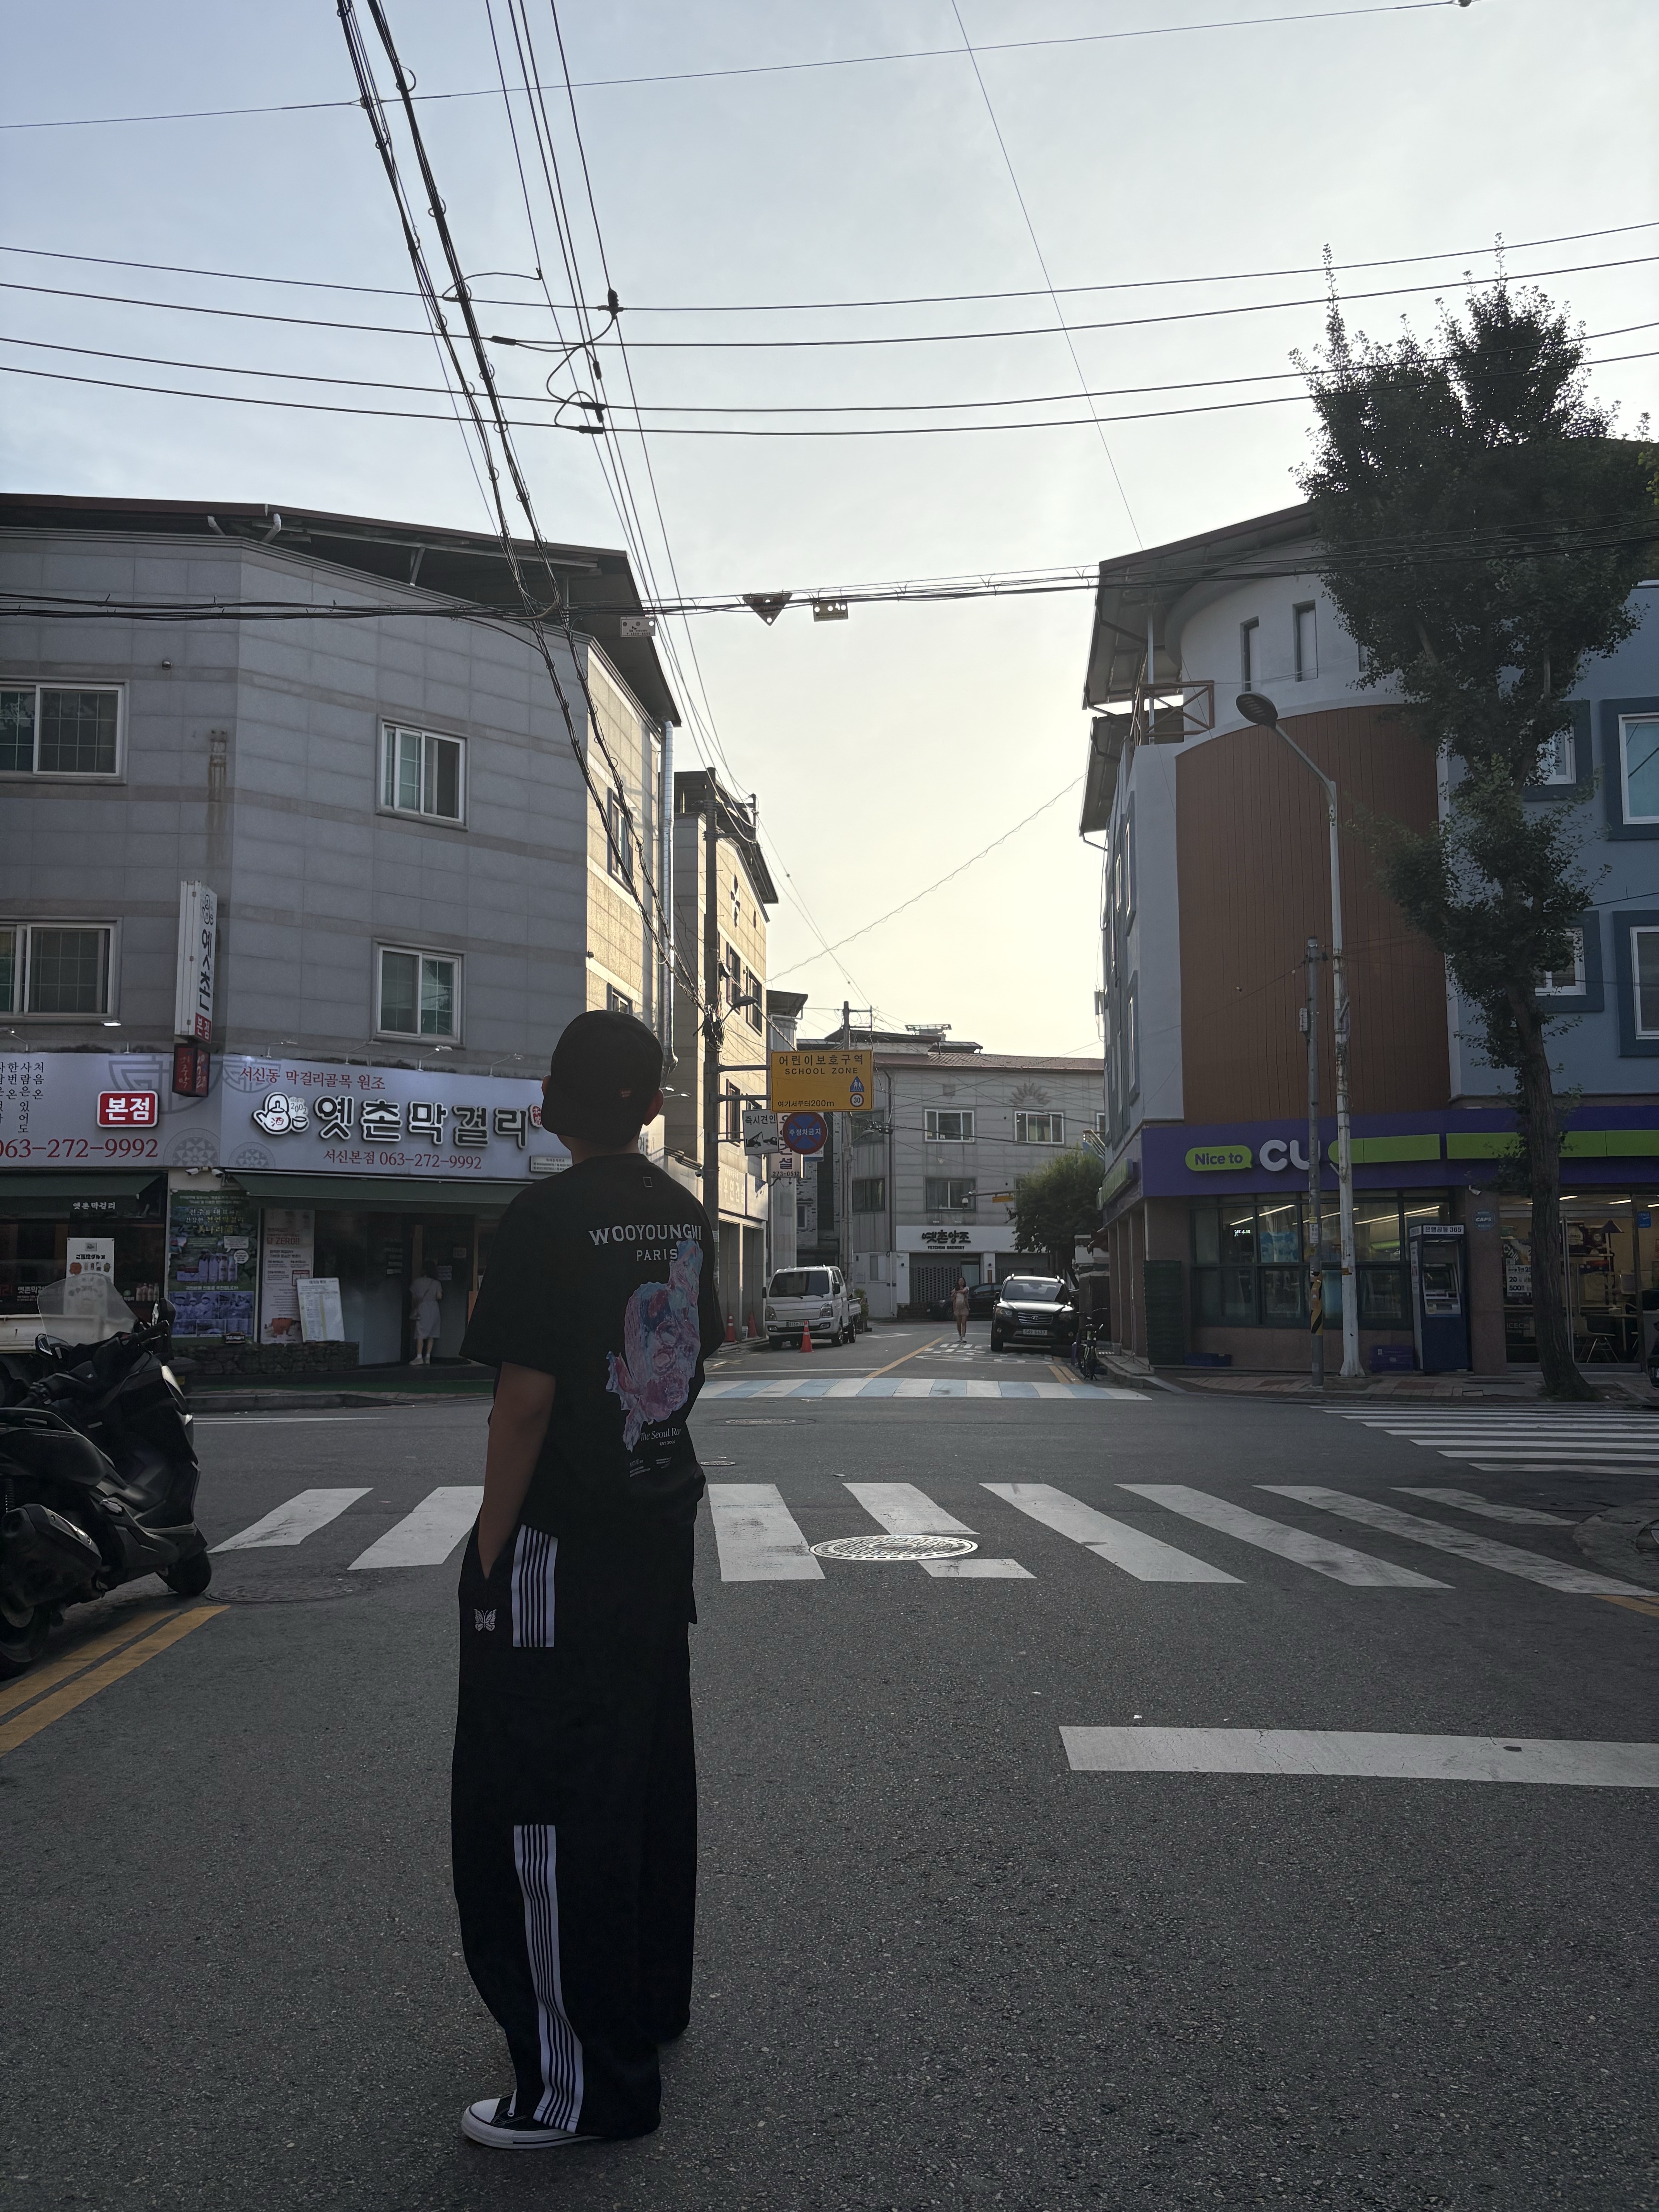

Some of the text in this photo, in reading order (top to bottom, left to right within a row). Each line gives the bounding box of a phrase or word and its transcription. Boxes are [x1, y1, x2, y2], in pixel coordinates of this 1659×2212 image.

[196, 1015, 211, 1040] 본점
[779, 1054, 863, 1065] 어린이보호구역
[6, 1062, 19, 1100] 한번 온
[32, 1061, 45, 1100] 처음 온
[239, 1066, 385, 1090] 서신동 막걸리골목 원조
[17, 1061, 32, 1133] 사람은 있어도
[105, 1097, 149, 1121] 본점
[291, 1103, 307, 1115] 2002
[744, 1114, 776, 1125] 즉시견인
[314, 1096, 527, 1147] 옛촌막걸리
[789, 1128, 821, 1137] 주정차금지
[323, 1149, 482, 1169] 서신본점 063-272-9992
[1194, 1139, 1321, 1171] Nice to CU
[921, 1229, 971, 1244] 옛촌양조
[636, 1249, 678, 1261] PARIS
[641, 1432, 650, 1441] The
[651, 1428, 670, 1439] Seoul
